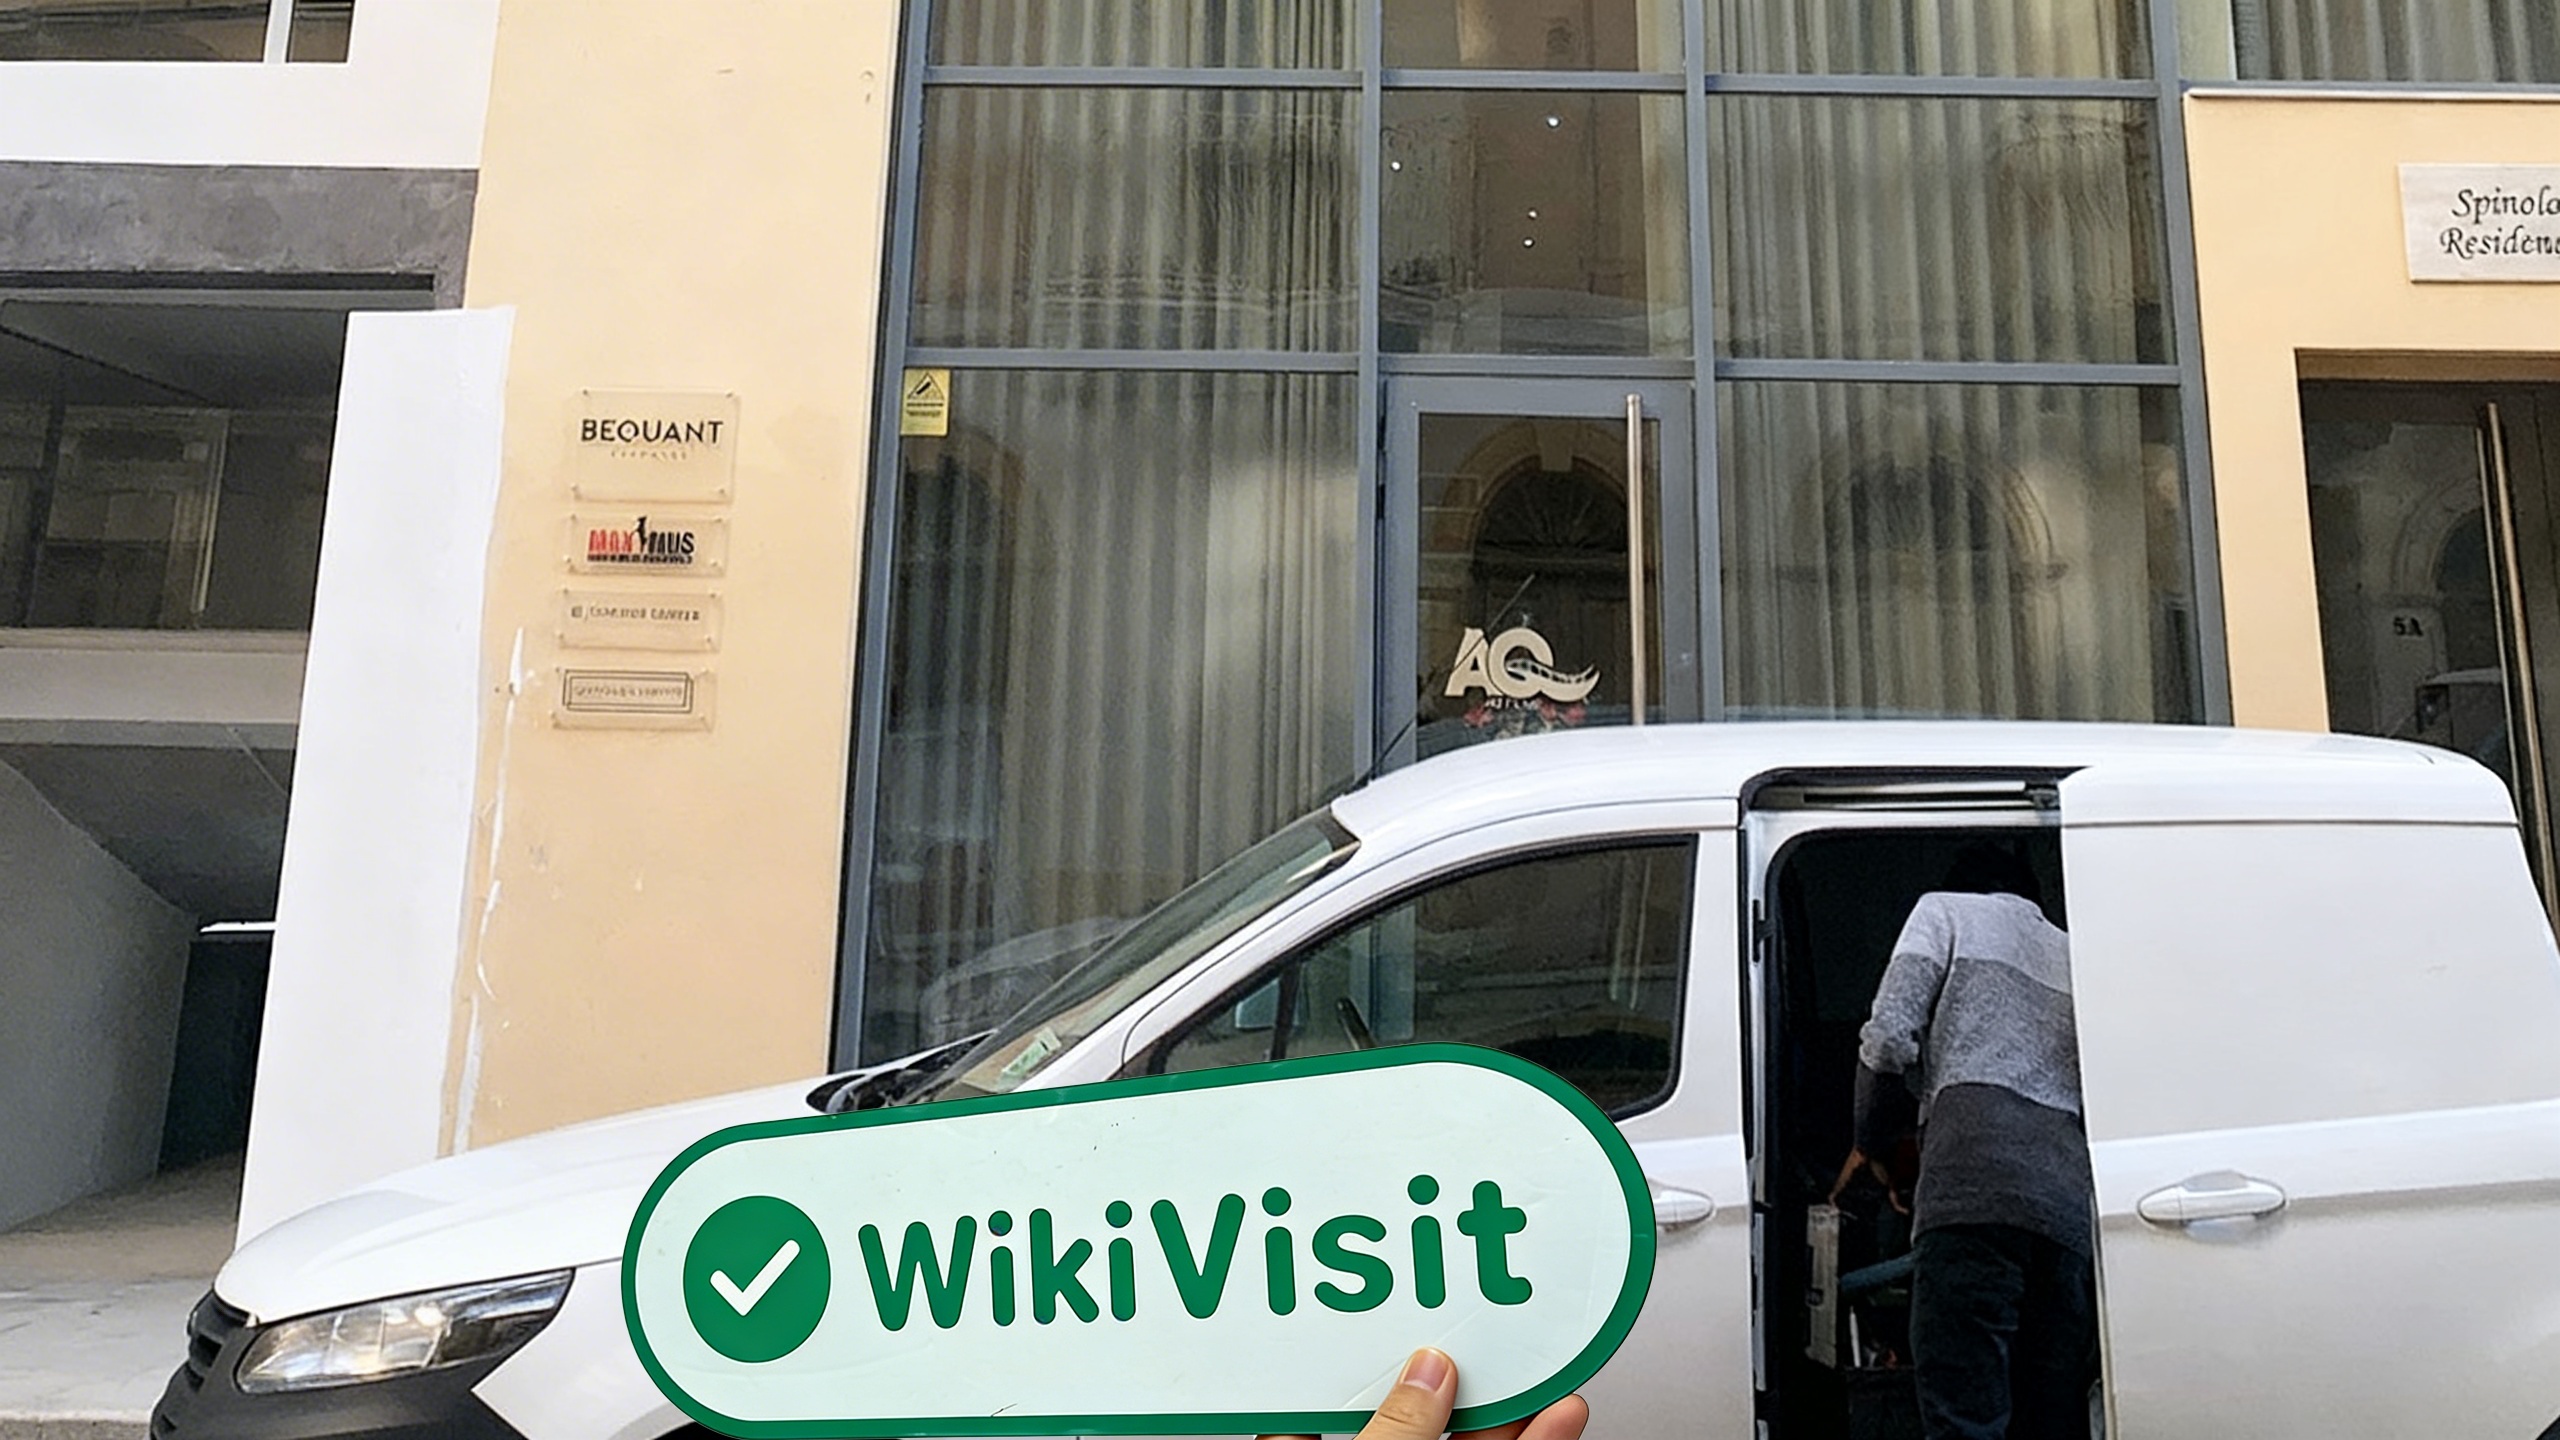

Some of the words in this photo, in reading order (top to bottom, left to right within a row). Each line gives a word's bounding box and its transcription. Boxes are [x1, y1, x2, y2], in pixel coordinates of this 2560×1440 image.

[2451, 184, 2560, 225] Spinola
[581, 419, 724, 444] BEQUANT
[858, 1173, 1533, 1332] WikiVisit
